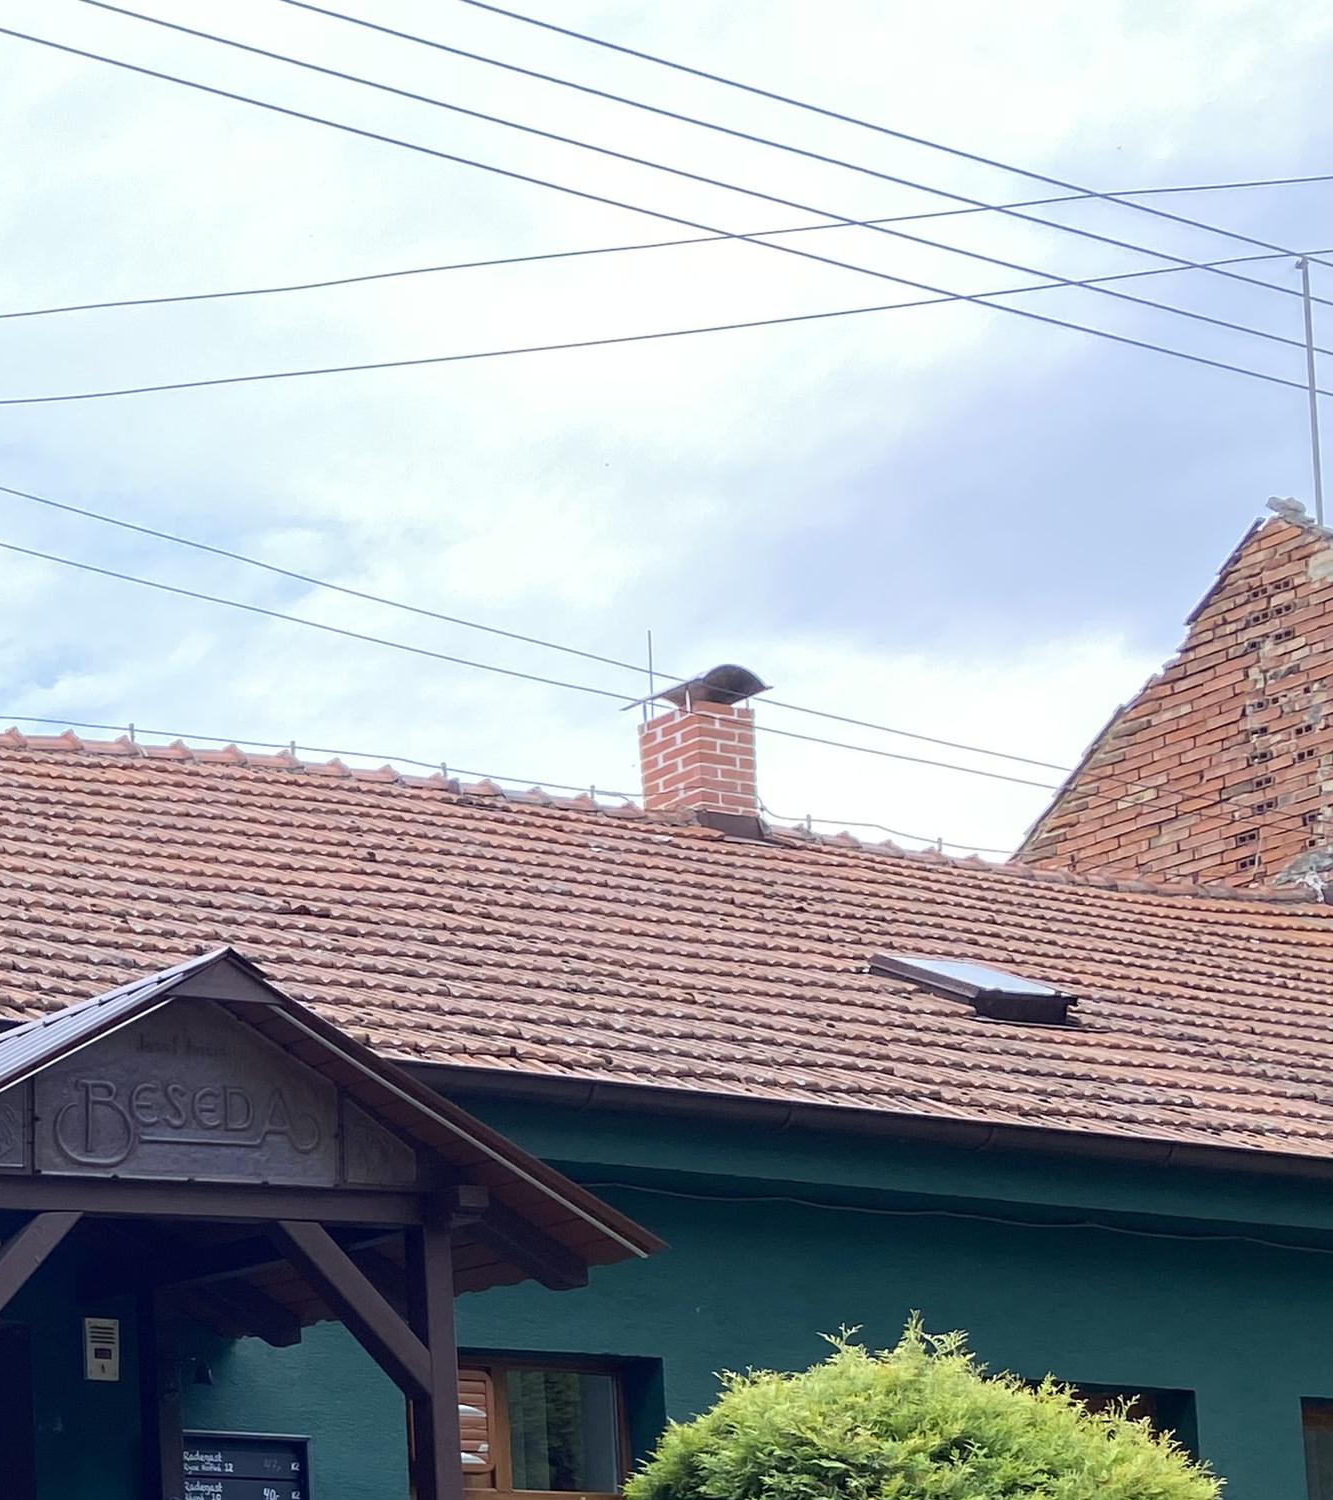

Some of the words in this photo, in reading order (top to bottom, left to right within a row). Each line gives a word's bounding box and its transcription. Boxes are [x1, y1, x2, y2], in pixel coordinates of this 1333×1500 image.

[183, 1451, 222, 1464] Radegast
[224, 1462, 234, 1473] 12
[184, 1481, 222, 1495] Radegast
